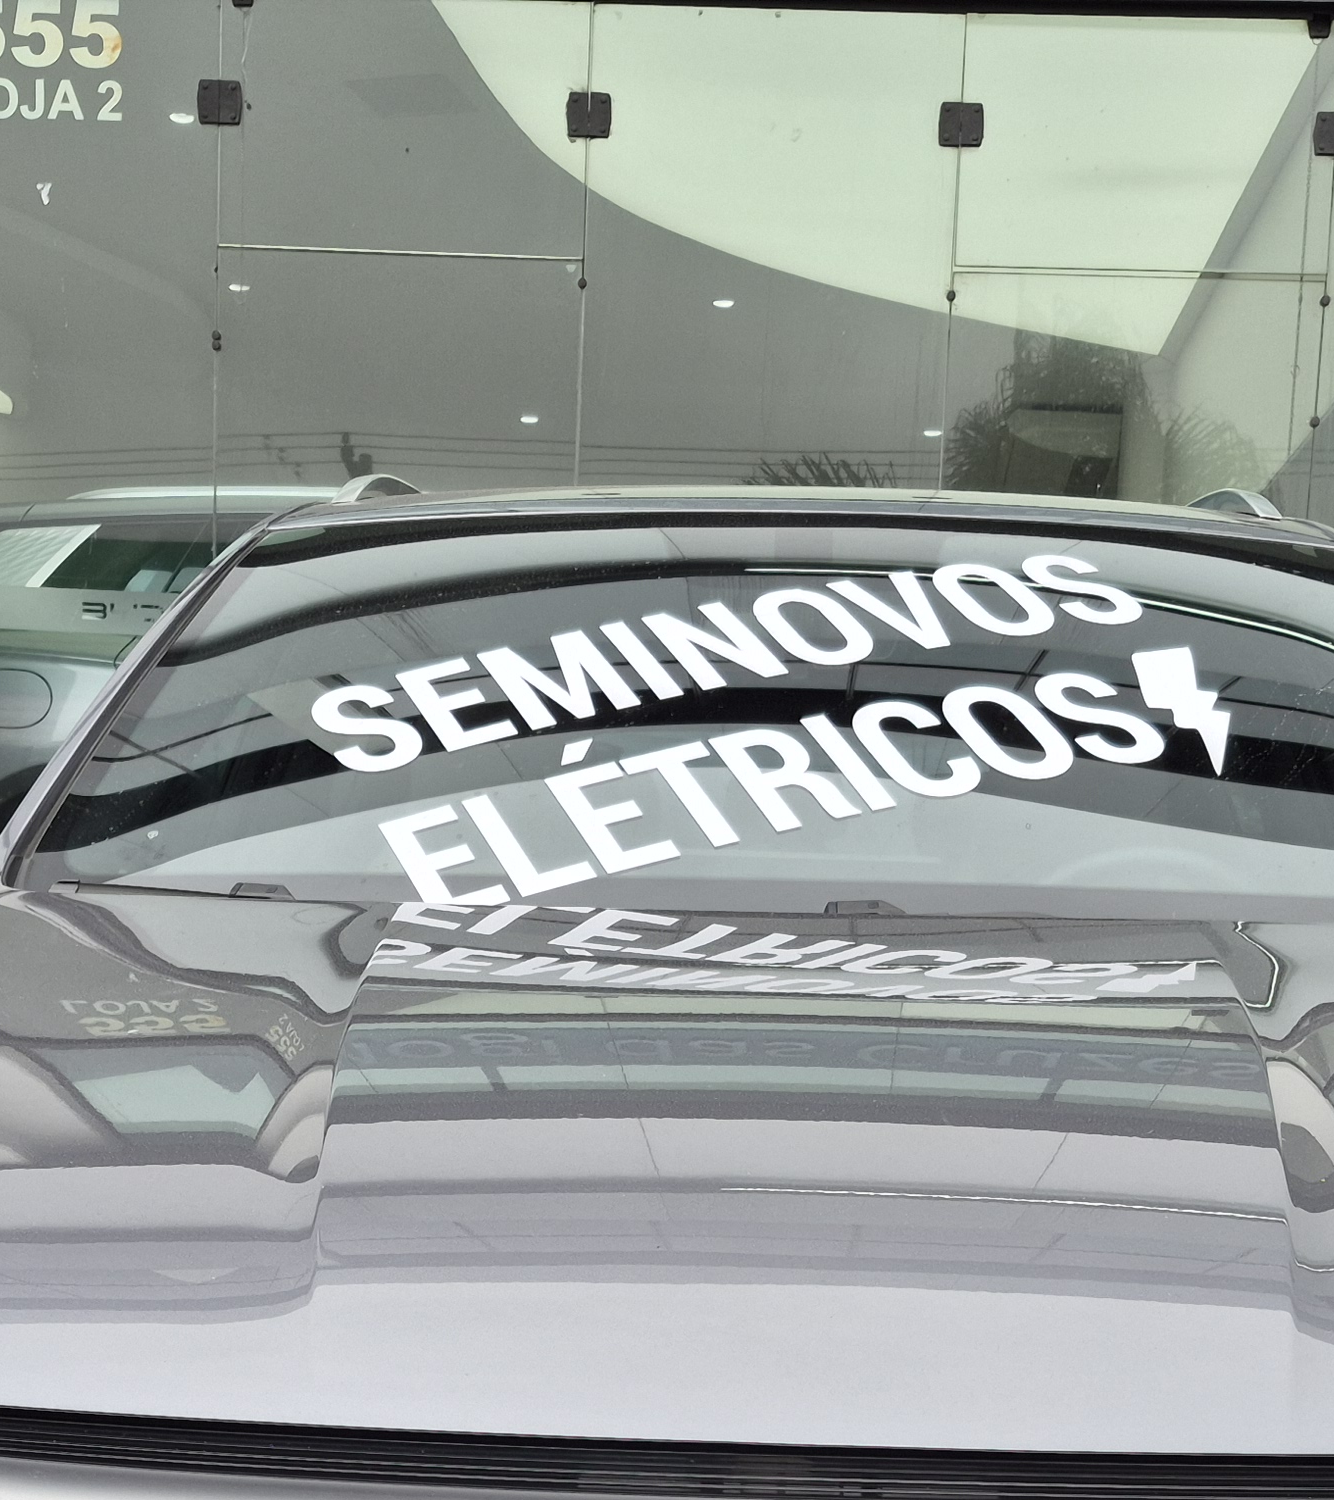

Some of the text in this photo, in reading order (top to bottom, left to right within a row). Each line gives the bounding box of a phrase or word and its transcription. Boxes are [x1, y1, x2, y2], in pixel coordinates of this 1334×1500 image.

[97, 80, 123, 121] 2
[310, 554, 1146, 774] SEMINOVOS
[379, 672, 1167, 905] ELÉTRICOS
